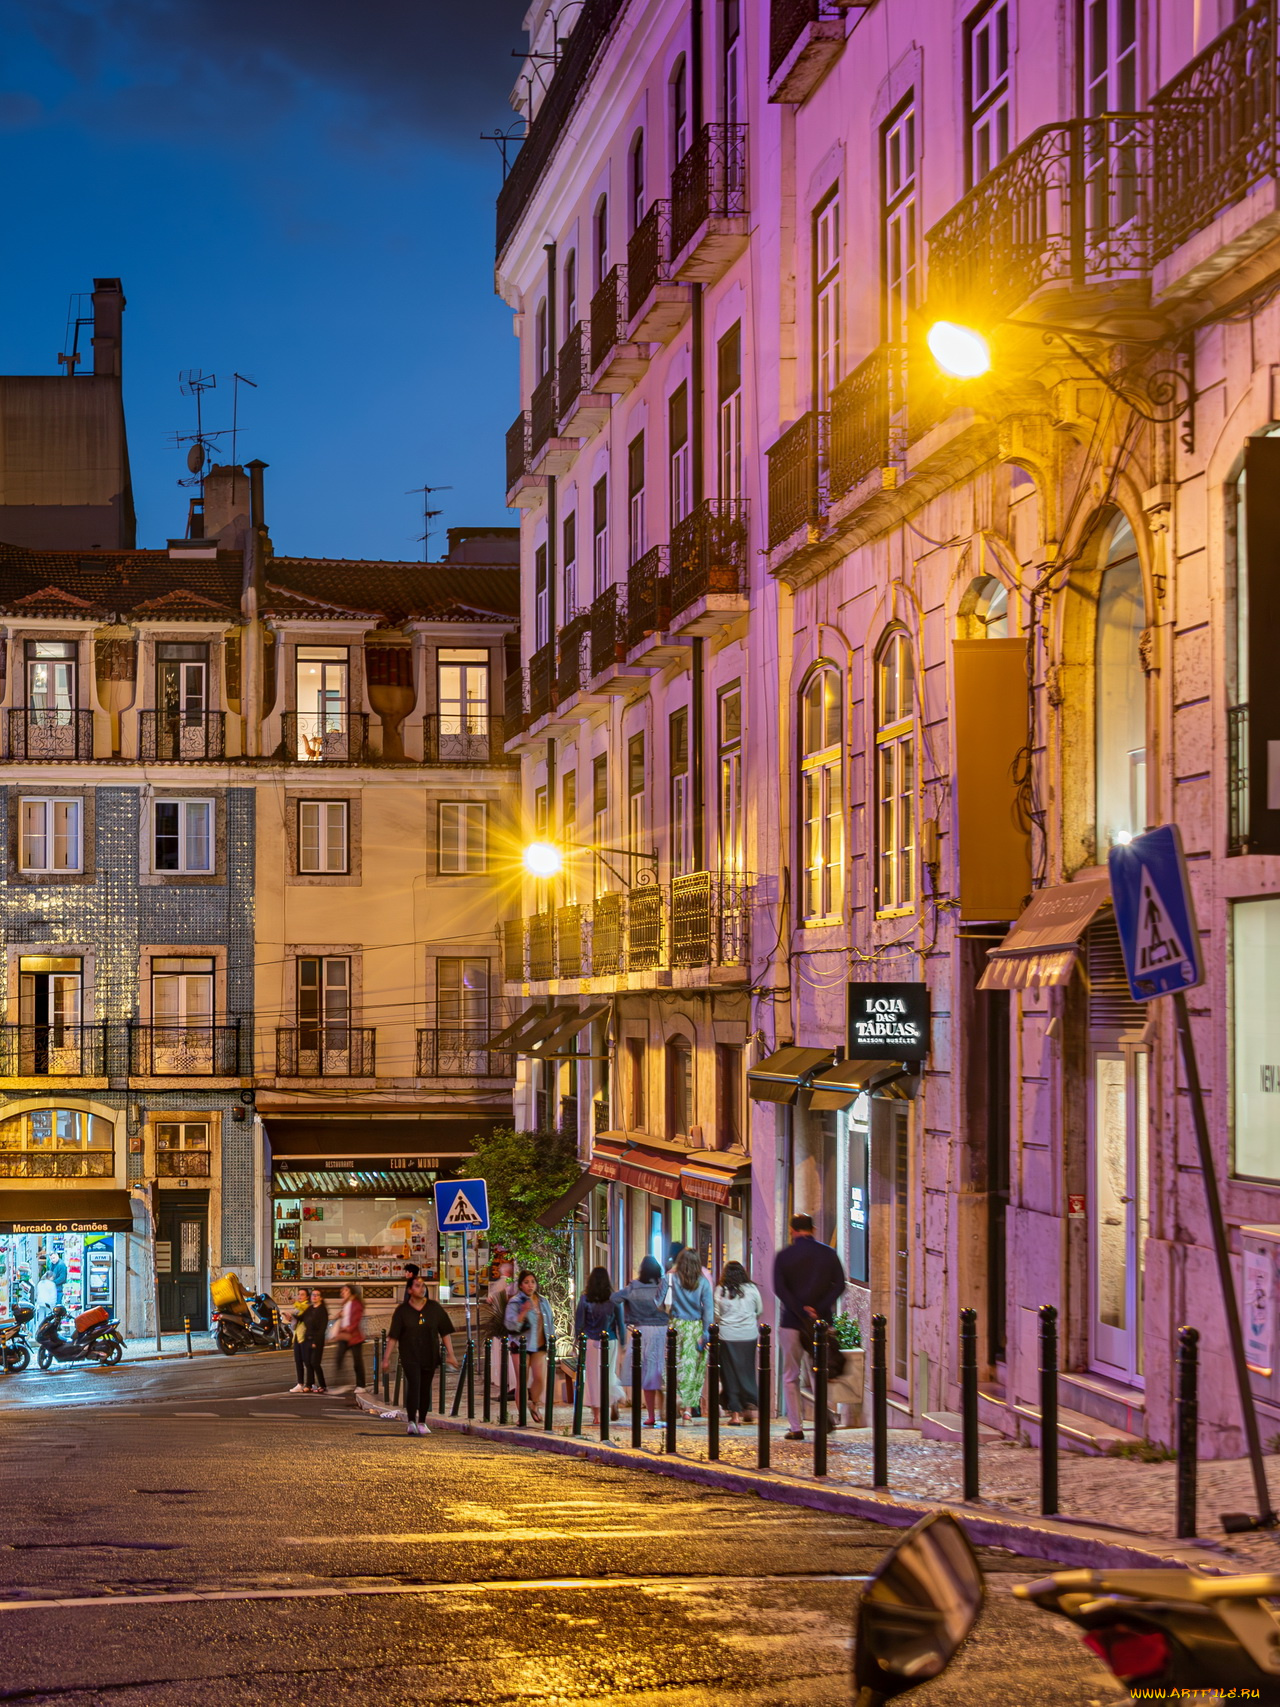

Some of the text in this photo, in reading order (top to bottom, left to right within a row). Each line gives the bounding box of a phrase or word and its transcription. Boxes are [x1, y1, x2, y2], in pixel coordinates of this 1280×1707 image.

[866, 999, 906, 1013] LOJA
[875, 1013, 896, 1022] DAS
[390, 1158, 406, 1169] FLOR
[417, 1158, 439, 1168] MUNDO
[12, 1222, 108, 1233] Mercado do Camões
